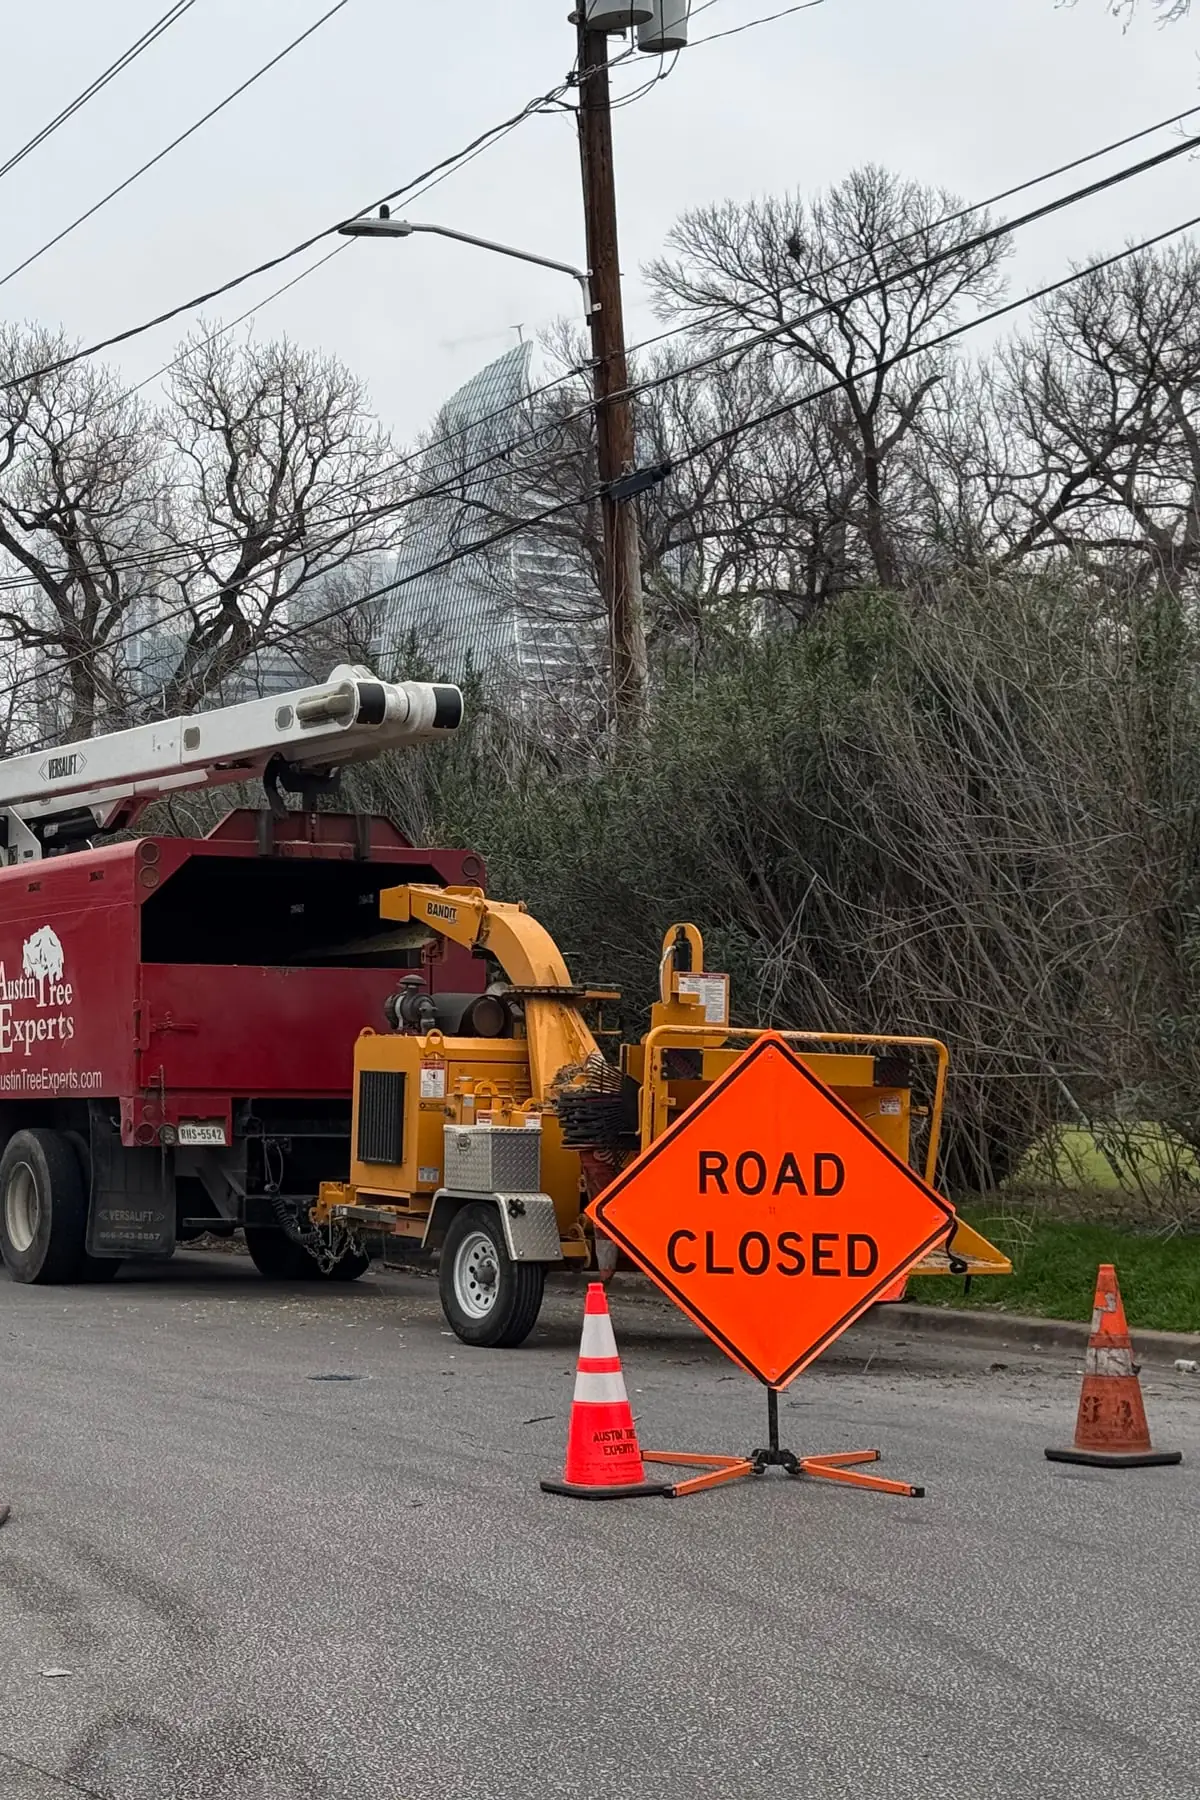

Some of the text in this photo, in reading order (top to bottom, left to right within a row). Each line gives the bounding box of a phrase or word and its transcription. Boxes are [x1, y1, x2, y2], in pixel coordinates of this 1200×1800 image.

[49, 753, 77, 780] VERSALIFT
[427, 902, 457, 919] BANDIT
[699, 1151, 845, 1196] ROAD
[667, 1229, 879, 1277] CLOSED
